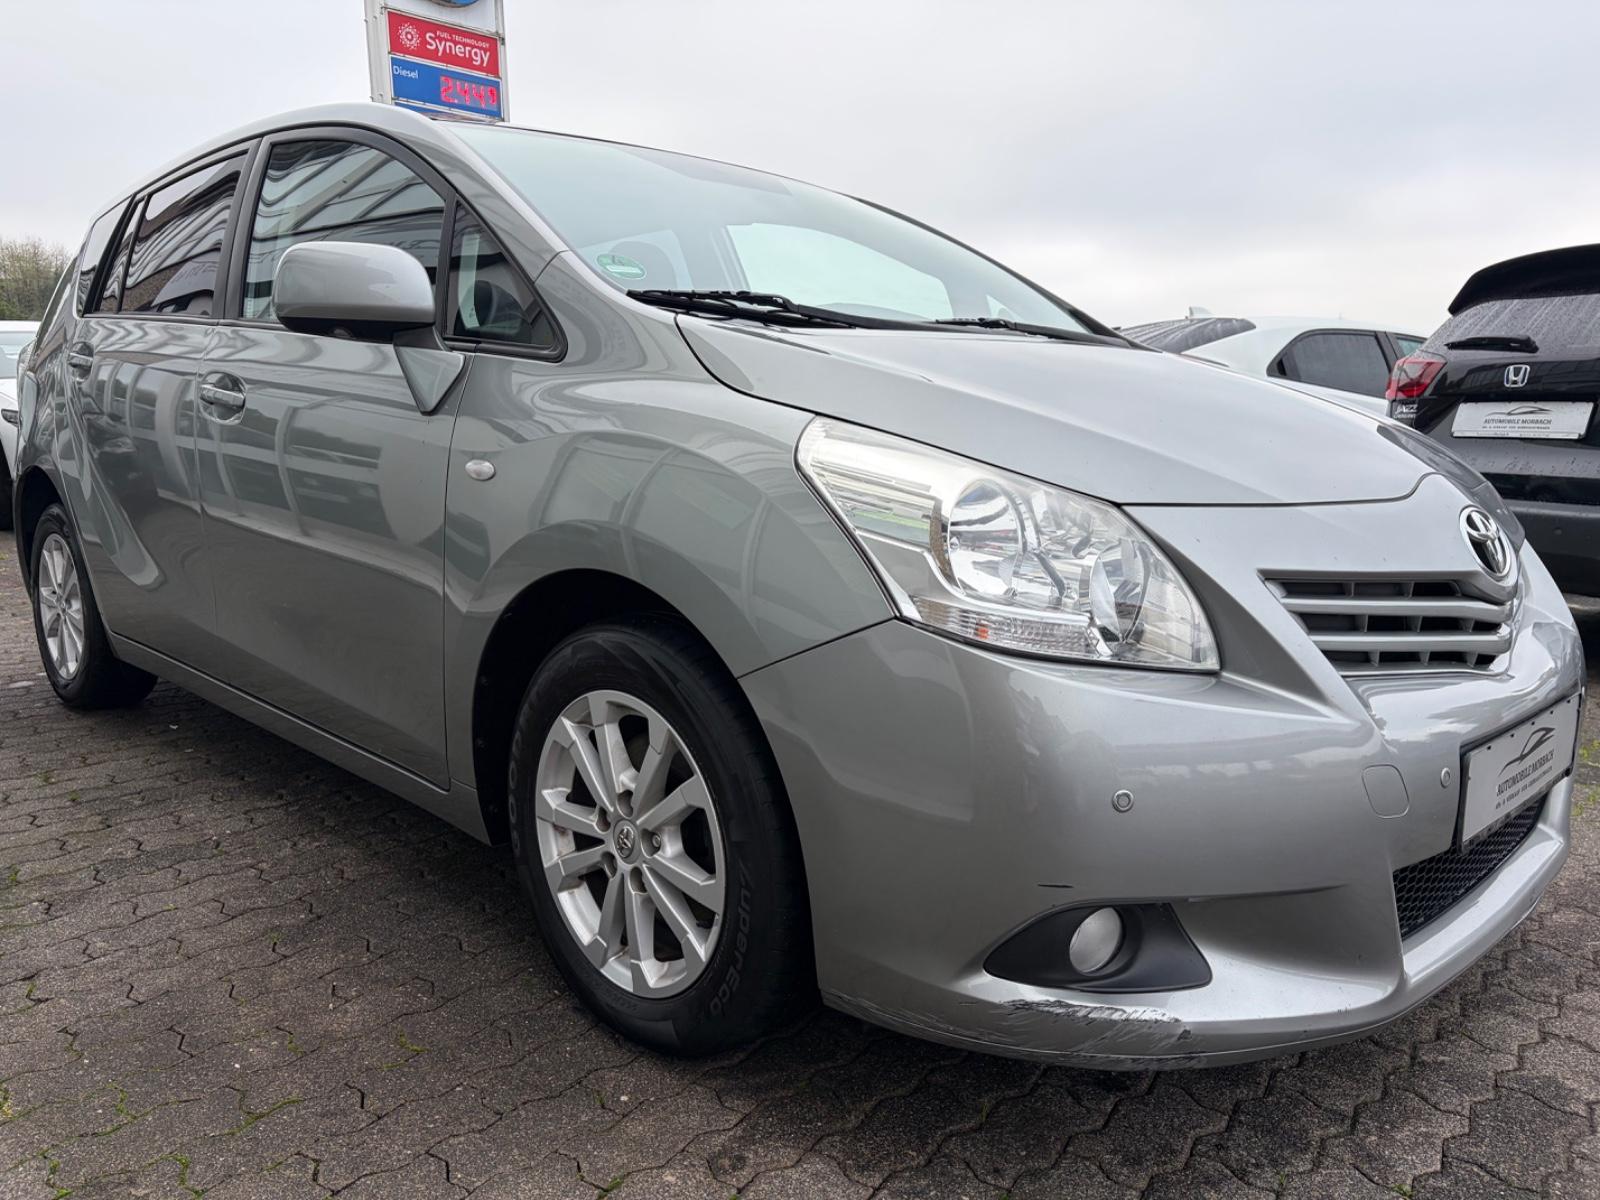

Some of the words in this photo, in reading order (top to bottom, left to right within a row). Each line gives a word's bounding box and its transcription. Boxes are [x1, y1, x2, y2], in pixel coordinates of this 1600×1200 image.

[437, 31, 451, 39] FUEL
[453, 35, 490, 48] TECHNOLOGY
[425, 32, 490, 67] Synergy
[393, 65, 419, 79] Diesel
